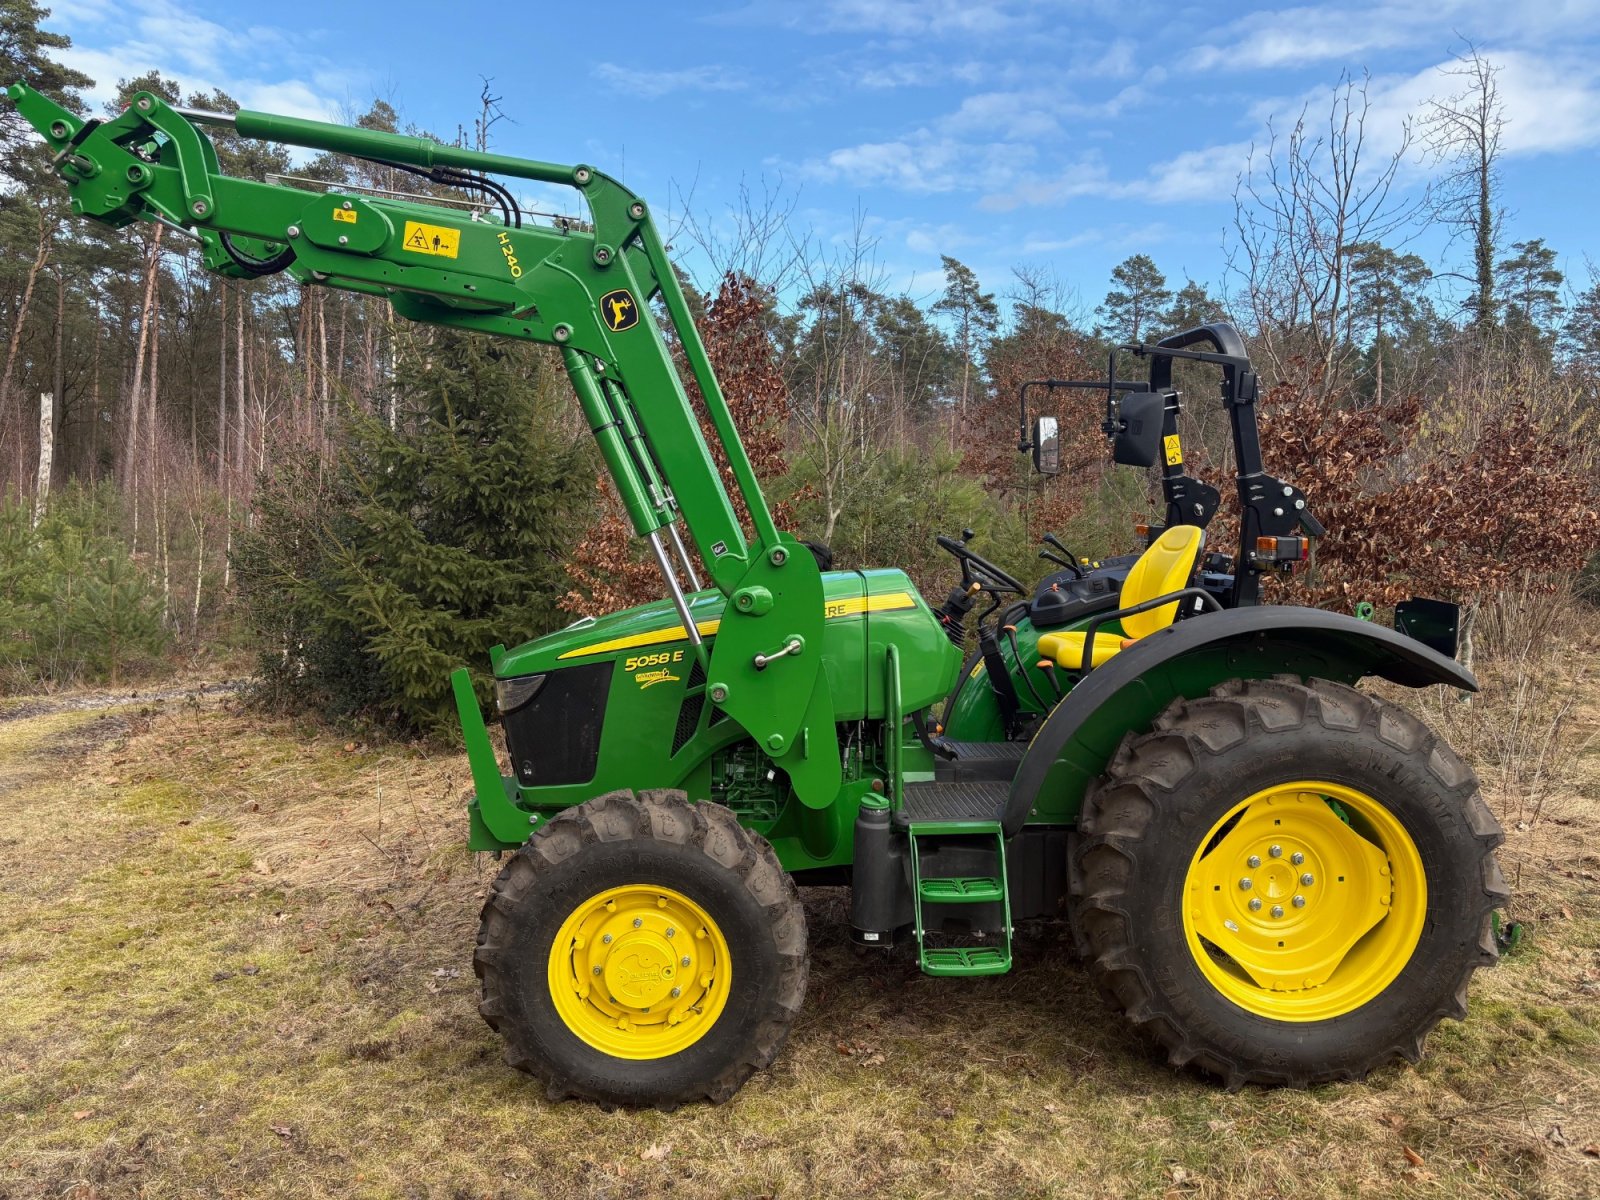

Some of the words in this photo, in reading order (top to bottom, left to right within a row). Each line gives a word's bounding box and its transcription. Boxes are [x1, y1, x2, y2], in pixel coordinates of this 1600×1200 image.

[824, 604, 846, 616] RE
[625, 653, 670, 671] 5058
[673, 650, 684, 662] E
